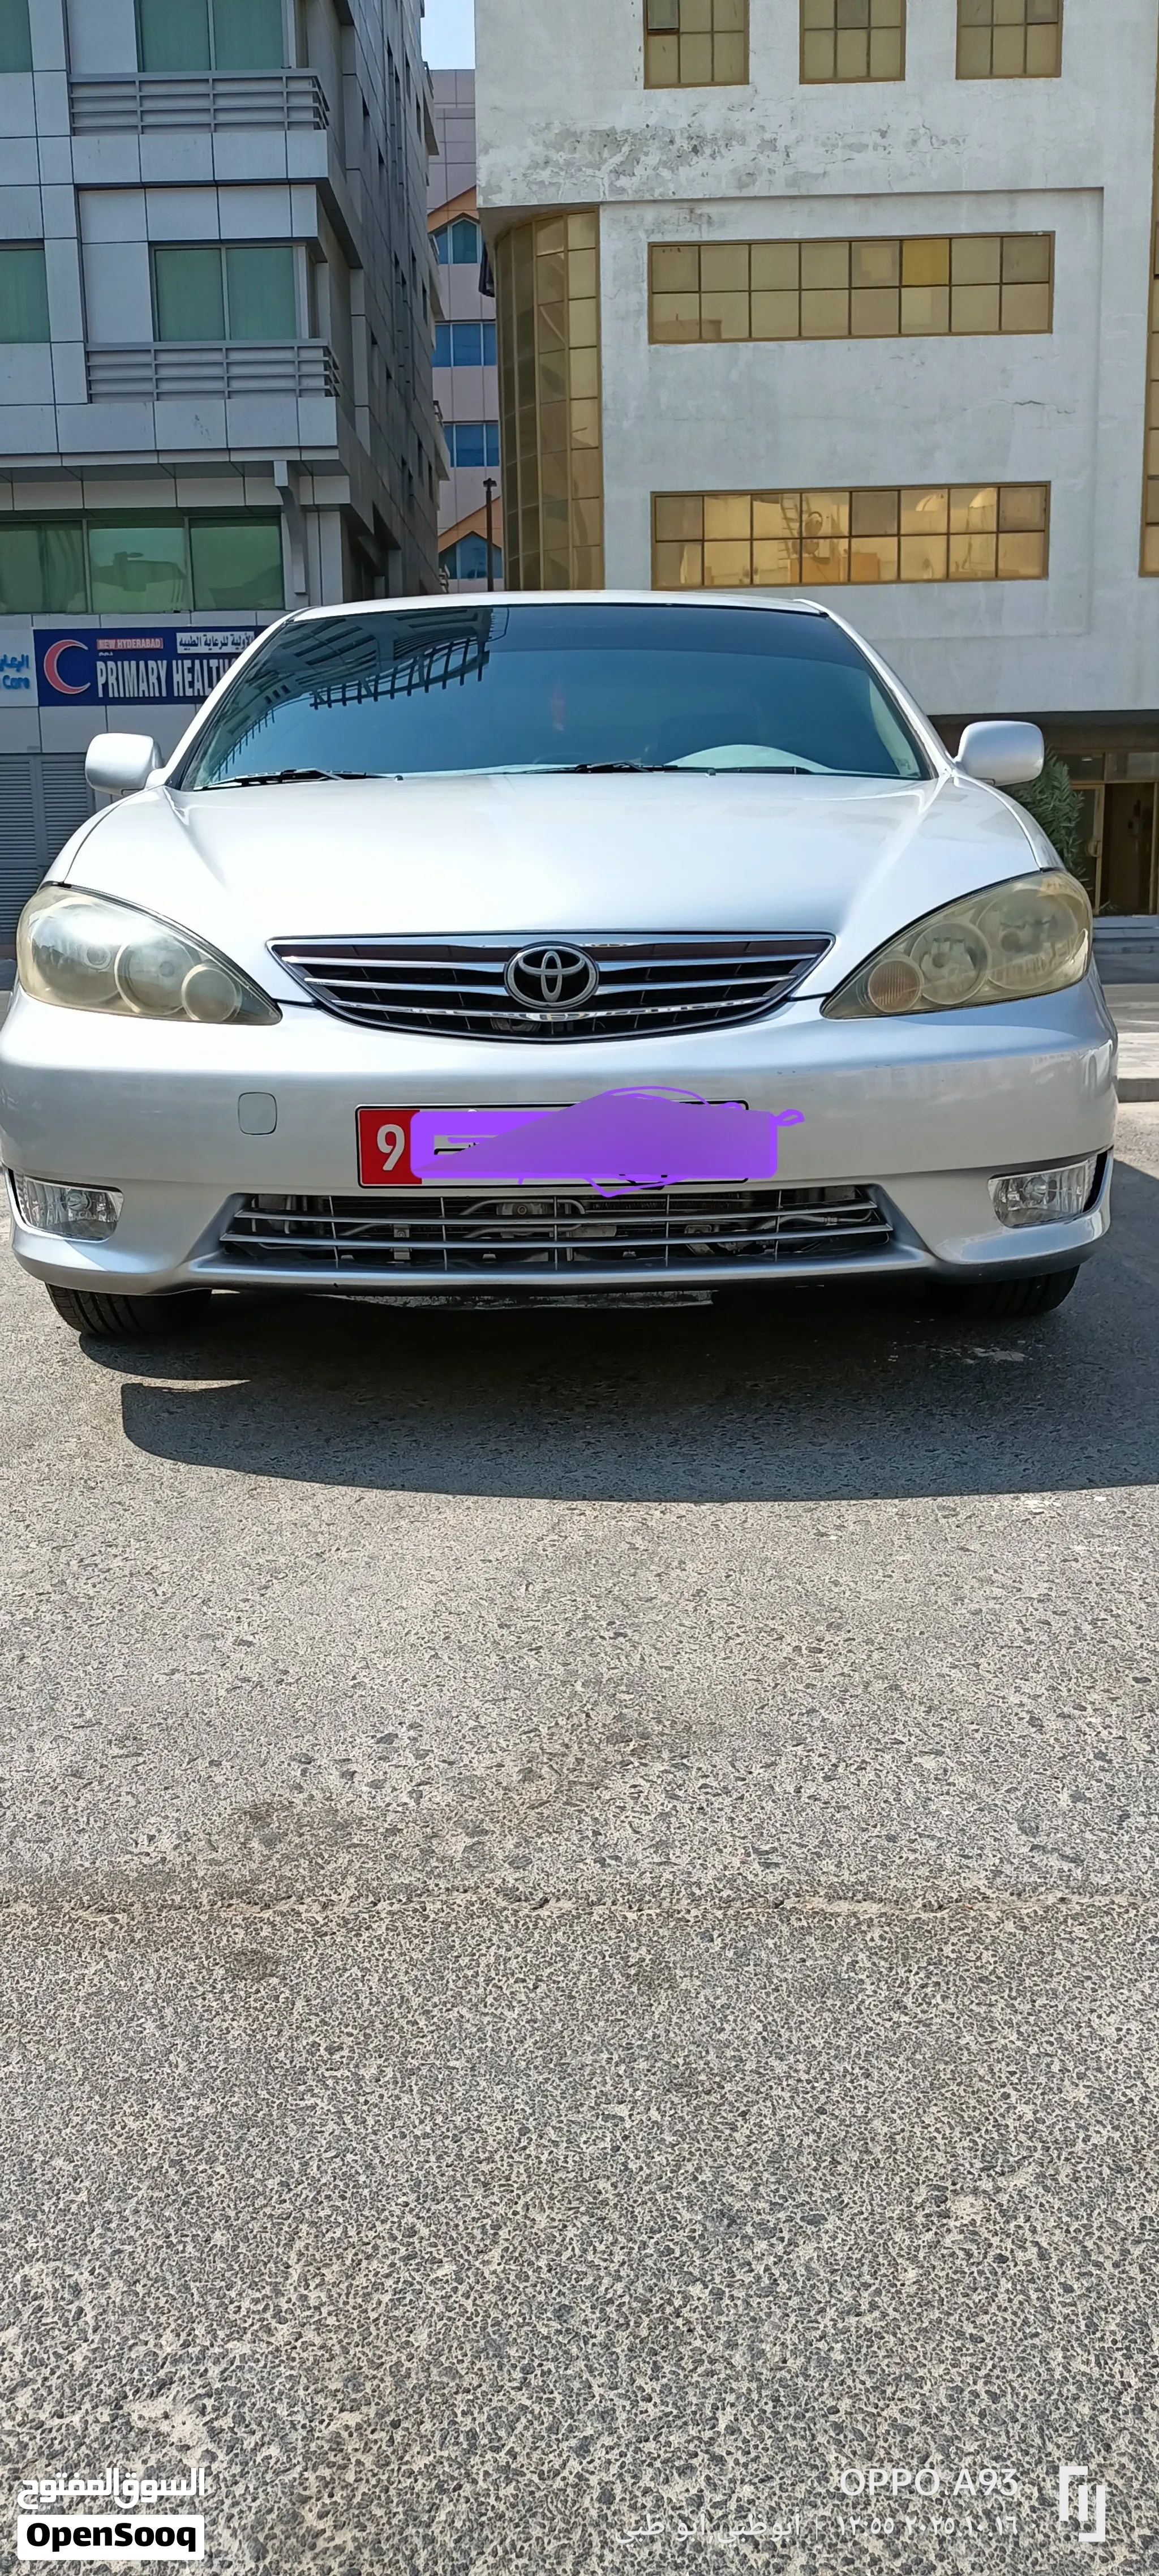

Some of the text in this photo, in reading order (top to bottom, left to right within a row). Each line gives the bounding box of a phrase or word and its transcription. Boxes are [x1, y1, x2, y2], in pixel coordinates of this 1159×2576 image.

[117, 638, 161, 649] HYDERABAD
[203, 634, 229, 650] للرعاية
[0, 654, 29, 672] الرعاي
[96, 660, 167, 698] PRIMARY
[377, 1124, 405, 1171] 9
